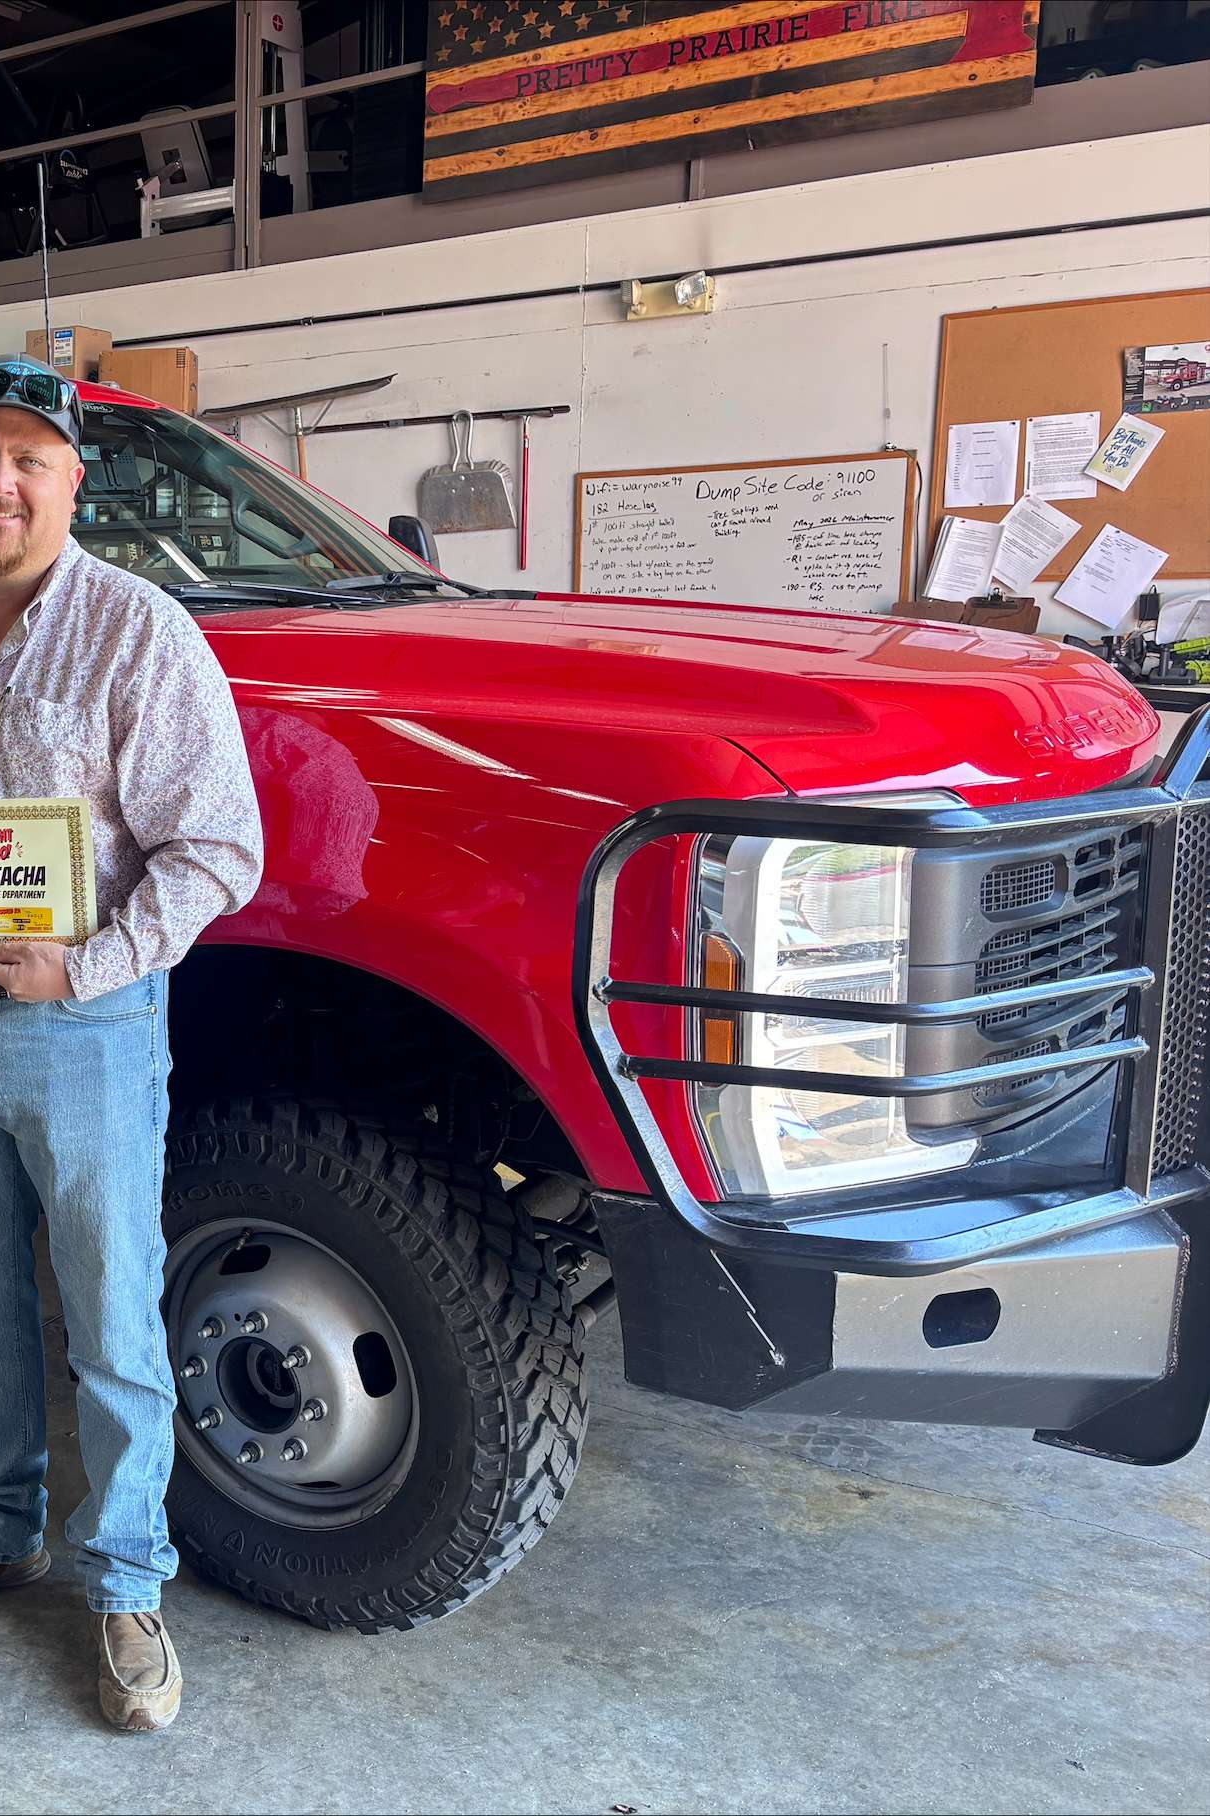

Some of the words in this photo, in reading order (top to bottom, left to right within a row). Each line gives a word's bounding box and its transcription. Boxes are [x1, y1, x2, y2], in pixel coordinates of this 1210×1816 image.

[515, 51, 641, 98] PRETTY
[668, 14, 810, 66] PRAIRIE
[1126, 430, 1148, 448] Thanks
[1103, 449, 1118, 464] You
[1116, 456, 1129, 467] Do
[1121, 444, 1137, 455] All
[696, 480, 741, 501] Dump
[744, 476, 778, 495] Site
[837, 469, 876, 483] 91100
[812, 492, 824, 502] or
[831, 488, 862, 500] siren
[2, 890, 46, 899] DEPARTMENT
